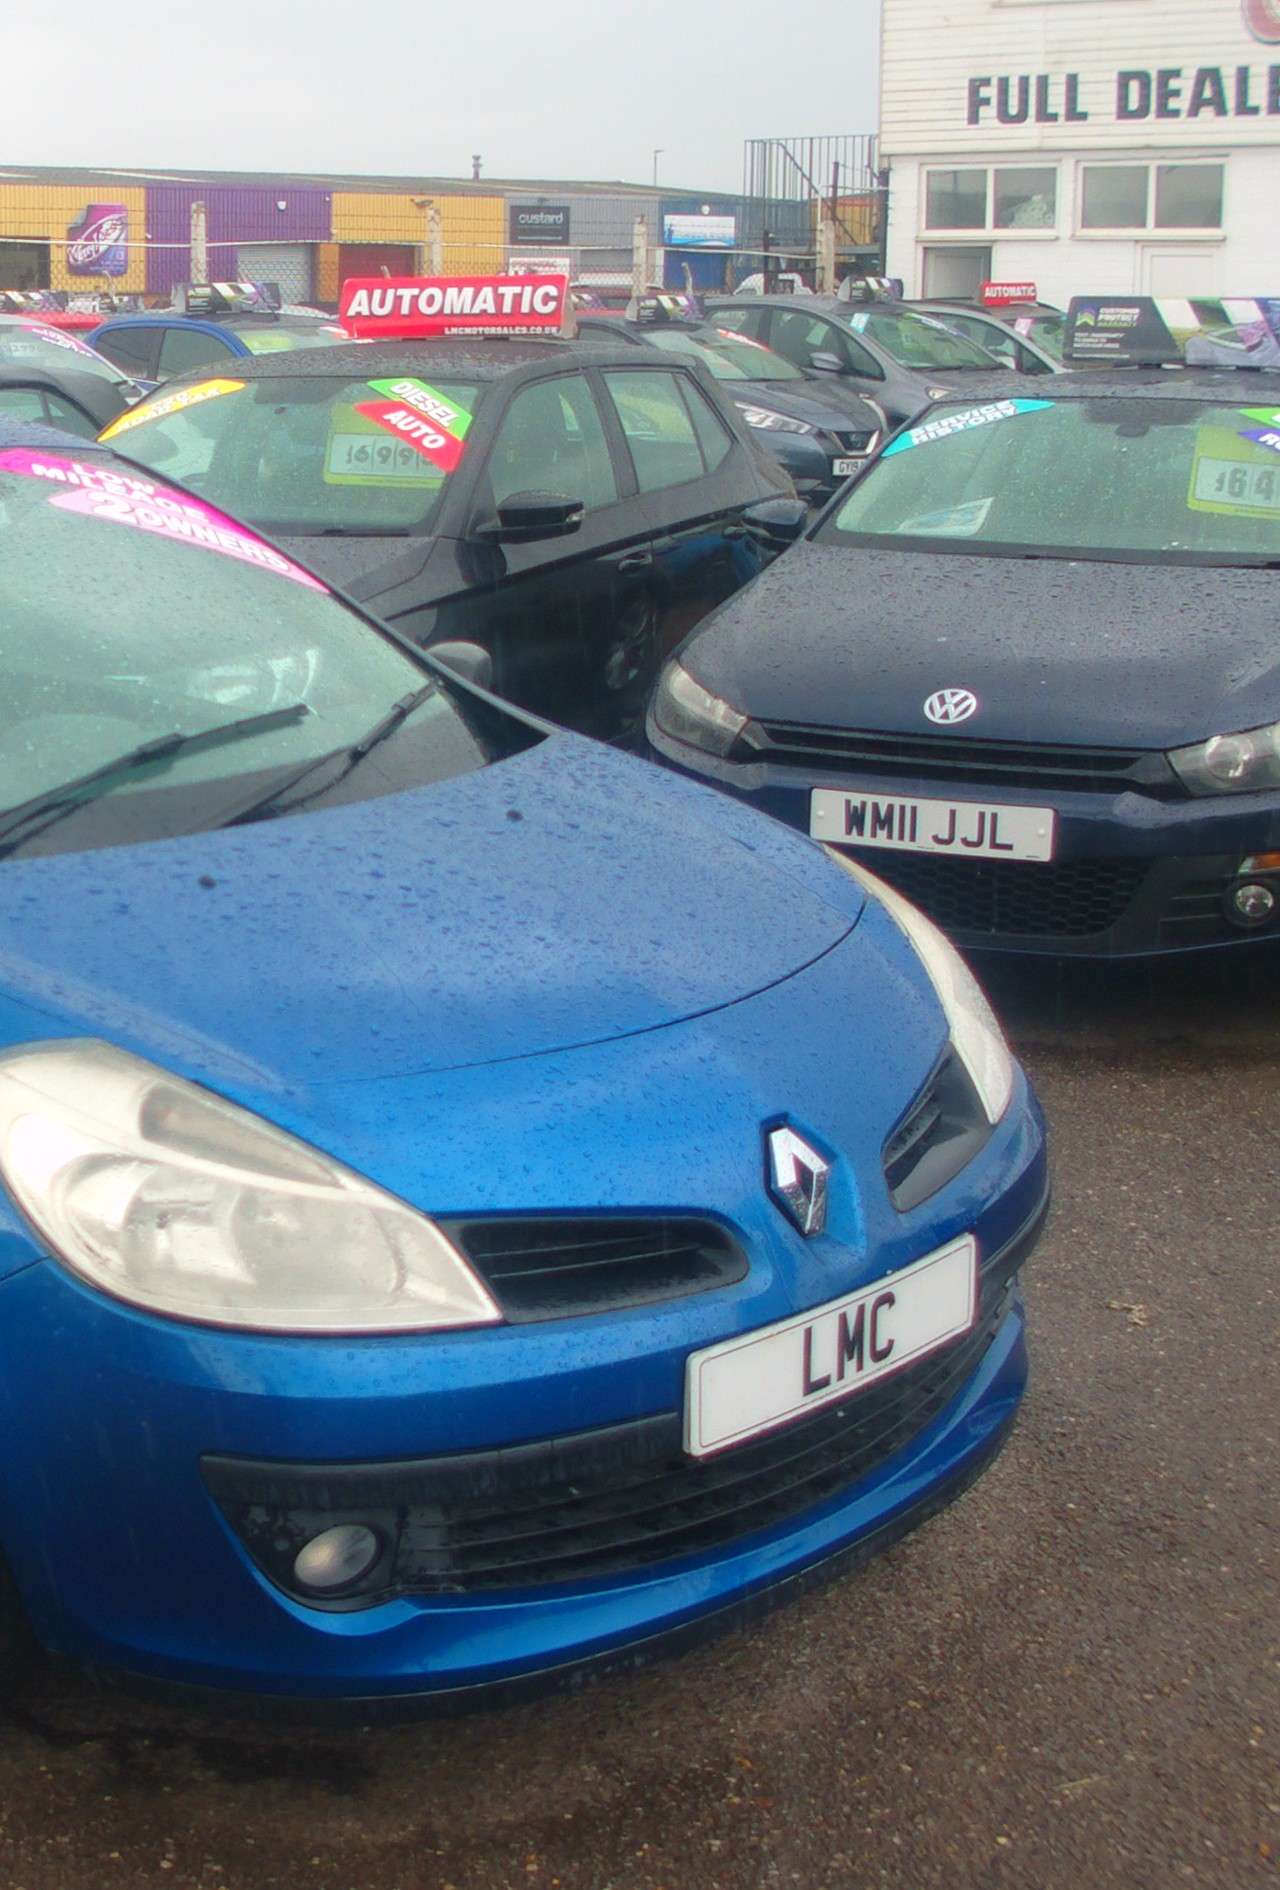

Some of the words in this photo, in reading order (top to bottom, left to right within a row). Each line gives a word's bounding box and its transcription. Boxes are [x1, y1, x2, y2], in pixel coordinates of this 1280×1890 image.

[967, 73, 1088, 126] FULL
[518, 211, 564, 225] custard
[346, 285, 558, 316] AUTOMATIC
[984, 286, 1037, 298] AUTOMATIC
[389, 381, 460, 428] DIESEL
[910, 400, 1016, 435] SERVICE
[382, 410, 446, 449] AUTO
[910, 406, 1018, 446] HISTORY
[30, 464, 209, 522] MILEAGE
[72, 463, 155, 495] LOW
[87, 490, 138, 526] 2
[931, 808, 1014, 851] JJL
[802, 1291, 896, 1398] LMC
